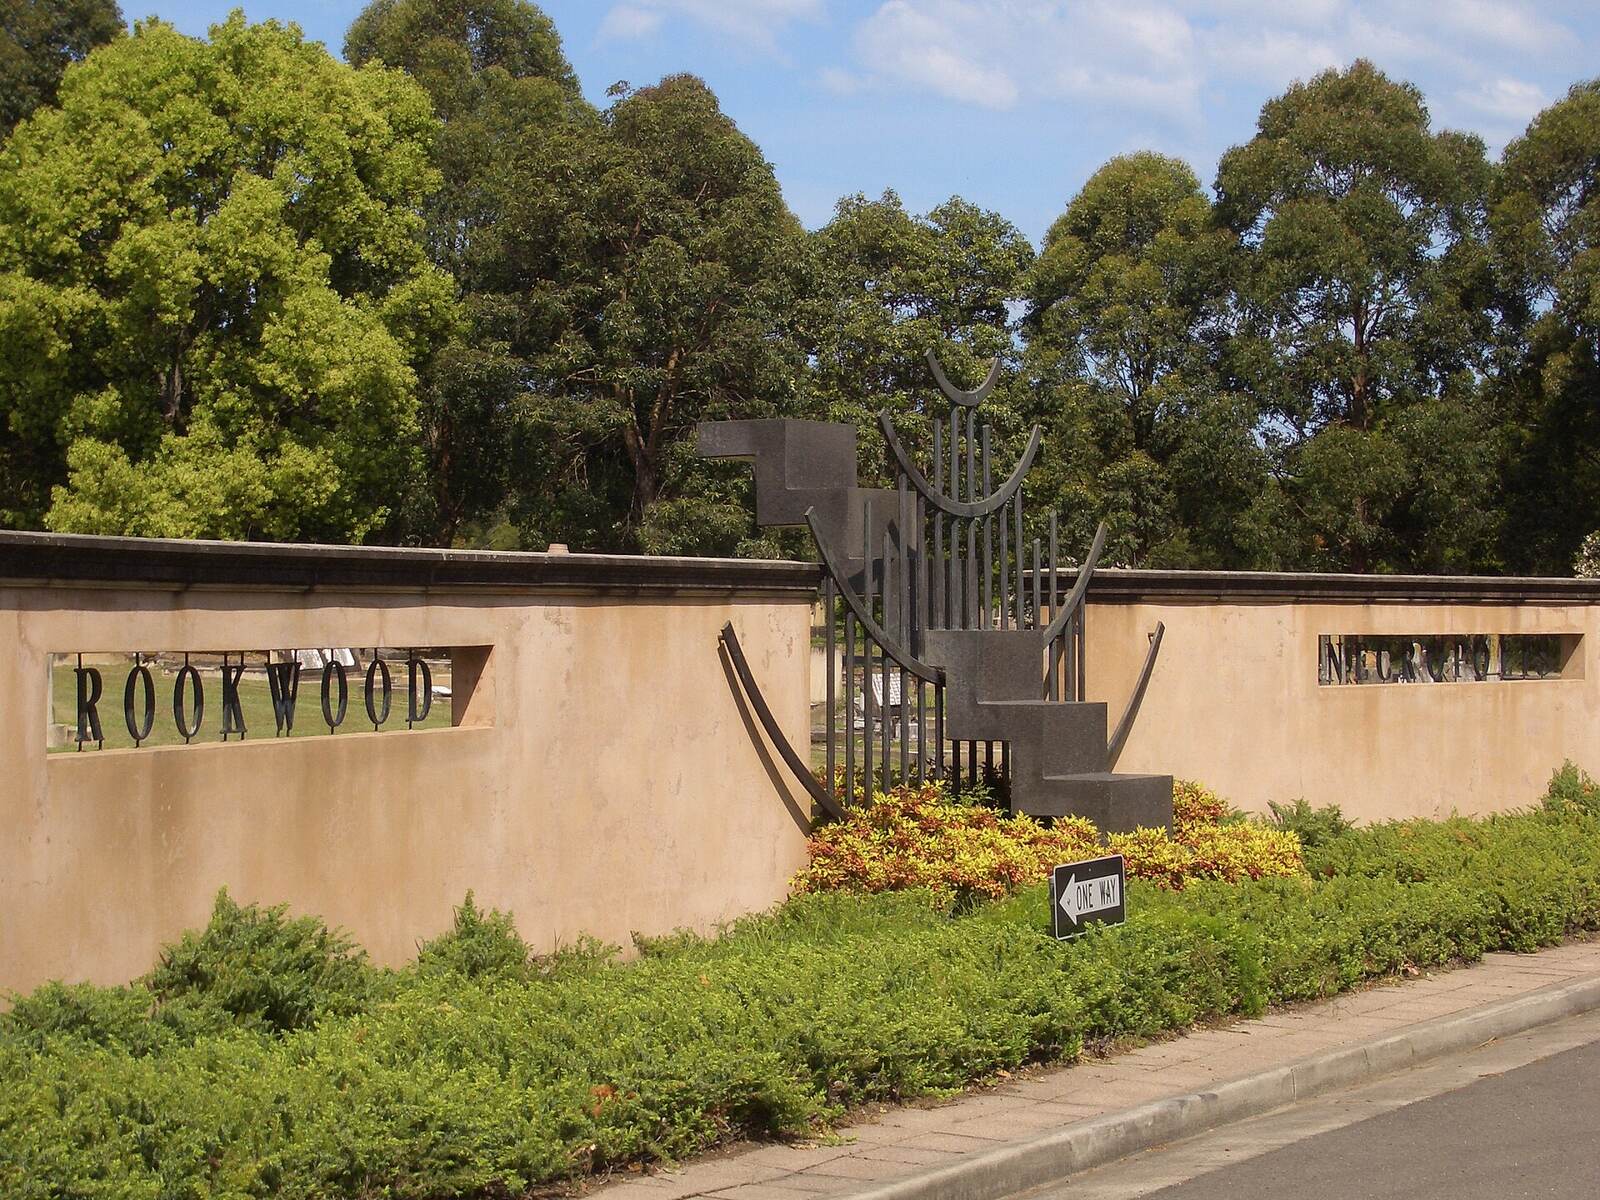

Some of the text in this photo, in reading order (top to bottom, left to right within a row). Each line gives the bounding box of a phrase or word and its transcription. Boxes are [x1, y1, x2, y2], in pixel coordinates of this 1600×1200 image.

[74, 658, 432, 742] ROOKWOOD
[1076, 878, 1116, 911] ONE WAY
